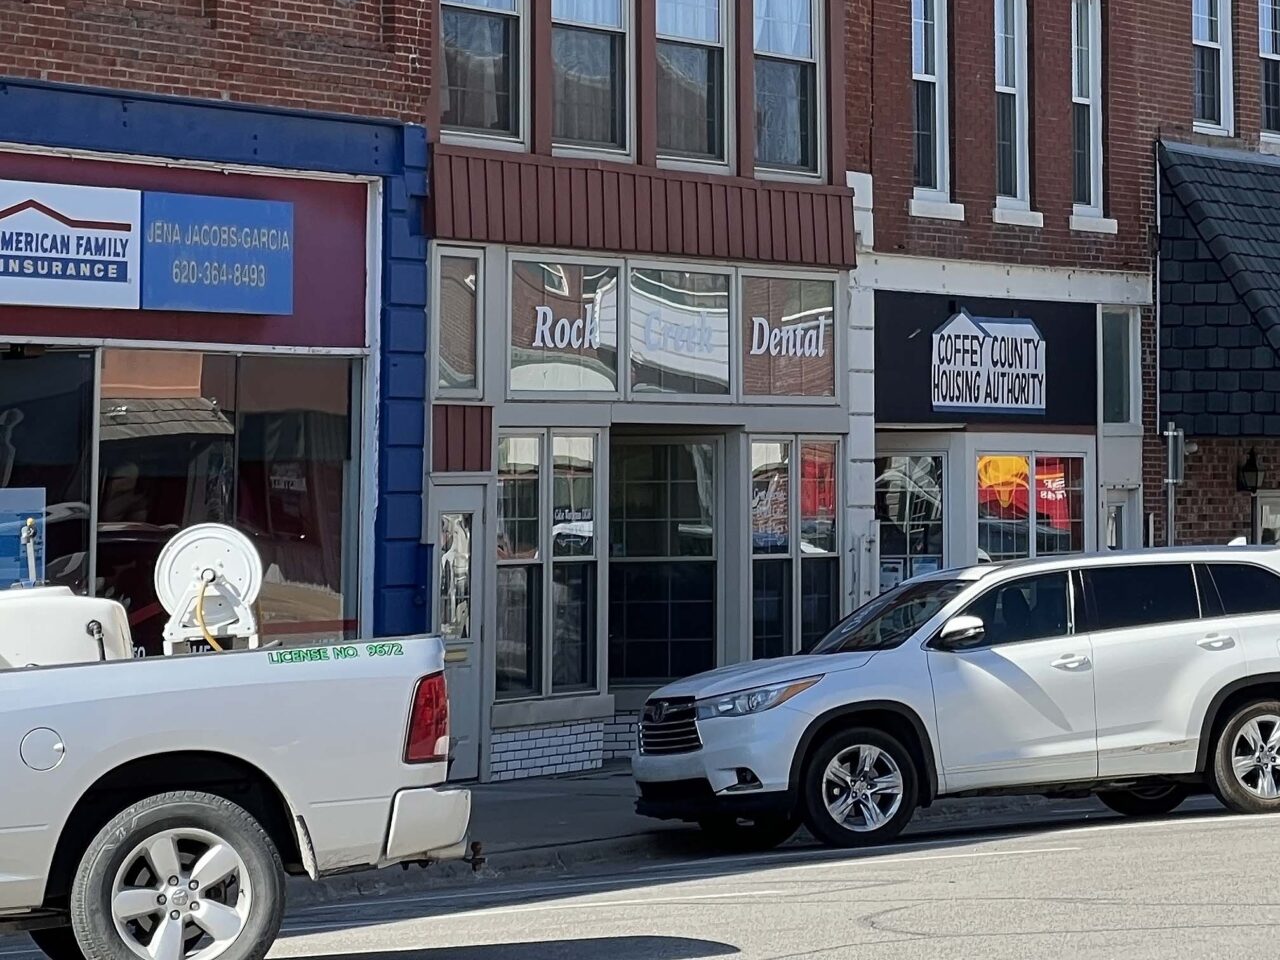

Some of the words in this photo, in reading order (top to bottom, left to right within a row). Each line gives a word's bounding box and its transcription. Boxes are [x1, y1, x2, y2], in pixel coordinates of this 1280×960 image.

[76, 235, 129, 259] FAMILY
[147, 222, 181, 243] JENA
[185, 225, 290, 250] JACOBS-GARCIA
[172, 260, 266, 287] 620-364-8493
[532, 303, 600, 350] Rock
[644, 309, 713, 353] Creek
[750, 315, 826, 358] Dental
[938, 333, 986, 367] COFFEY
[991, 335, 1041, 370] COUNTY
[932, 364, 981, 404] HOUSING
[984, 368, 1044, 406] AUTHORITY
[268, 648, 329, 664] LICENSE
[366, 643, 404, 656] 9672
